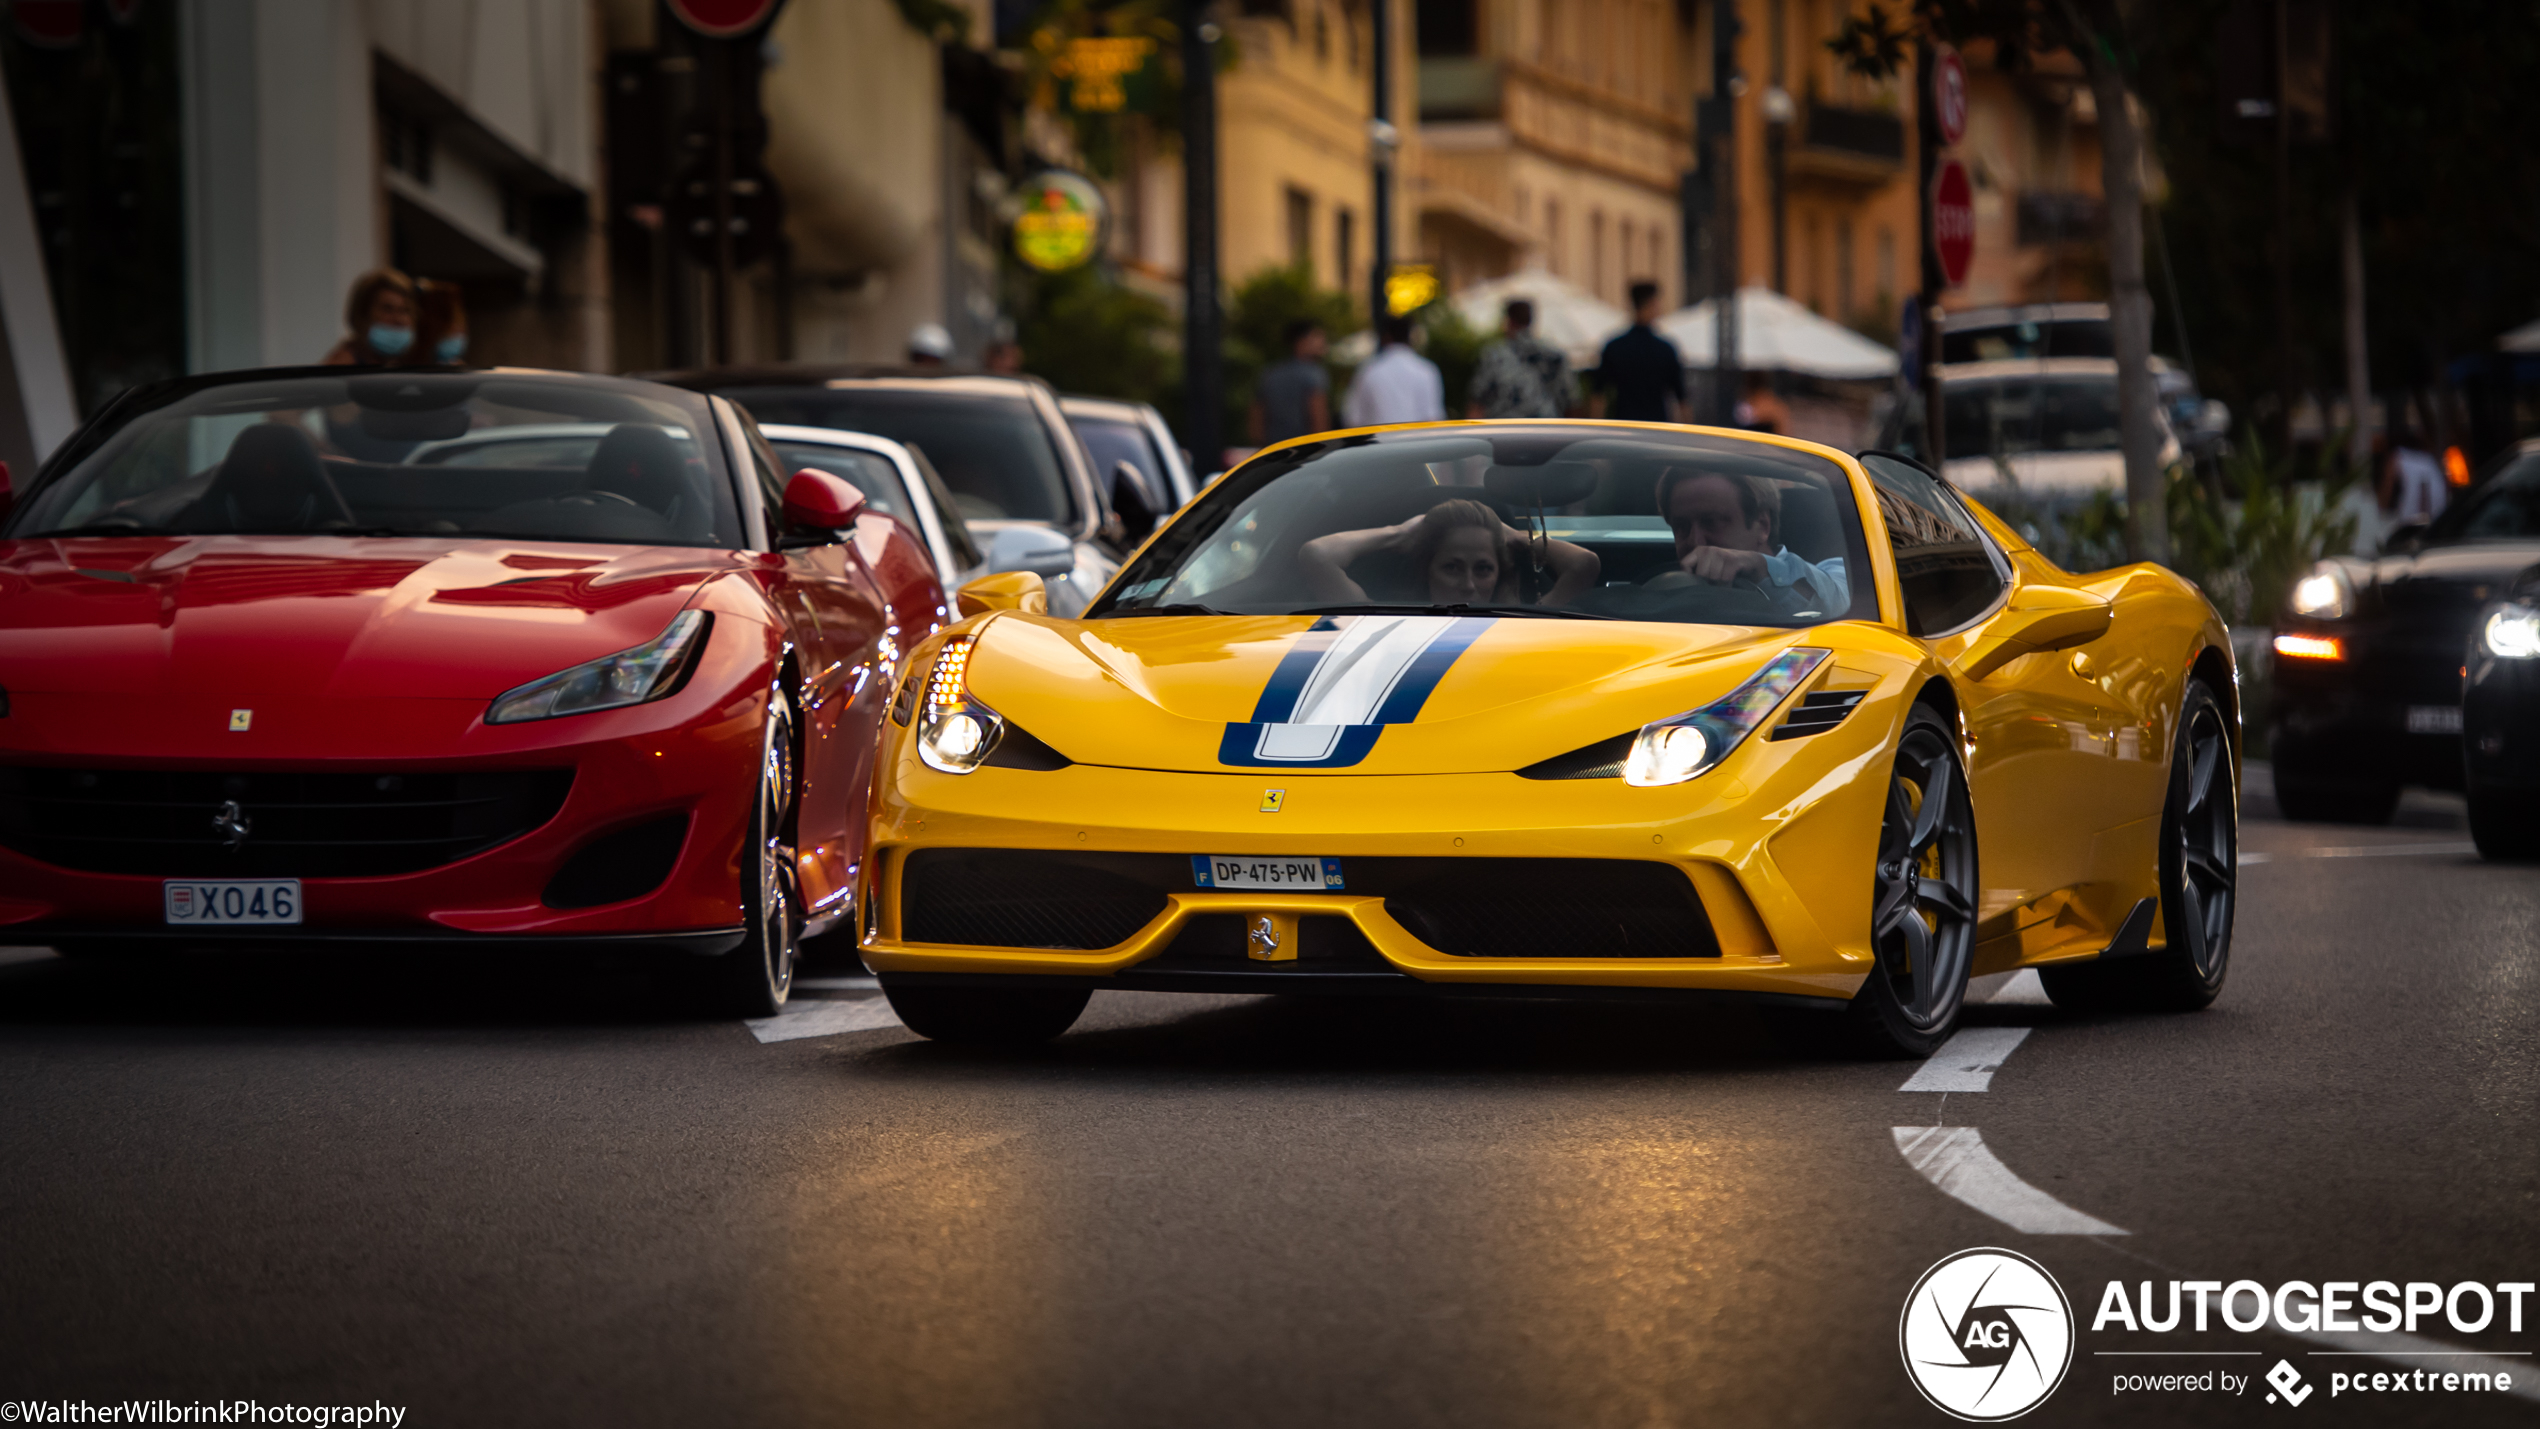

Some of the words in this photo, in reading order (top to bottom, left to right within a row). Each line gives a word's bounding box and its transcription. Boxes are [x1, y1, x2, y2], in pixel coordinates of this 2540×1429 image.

[1199, 872, 1208, 883] F
[1216, 862, 1316, 883] DP-475-PW
[1325, 874, 1343, 886] 06
[199, 886, 293, 919] X046
